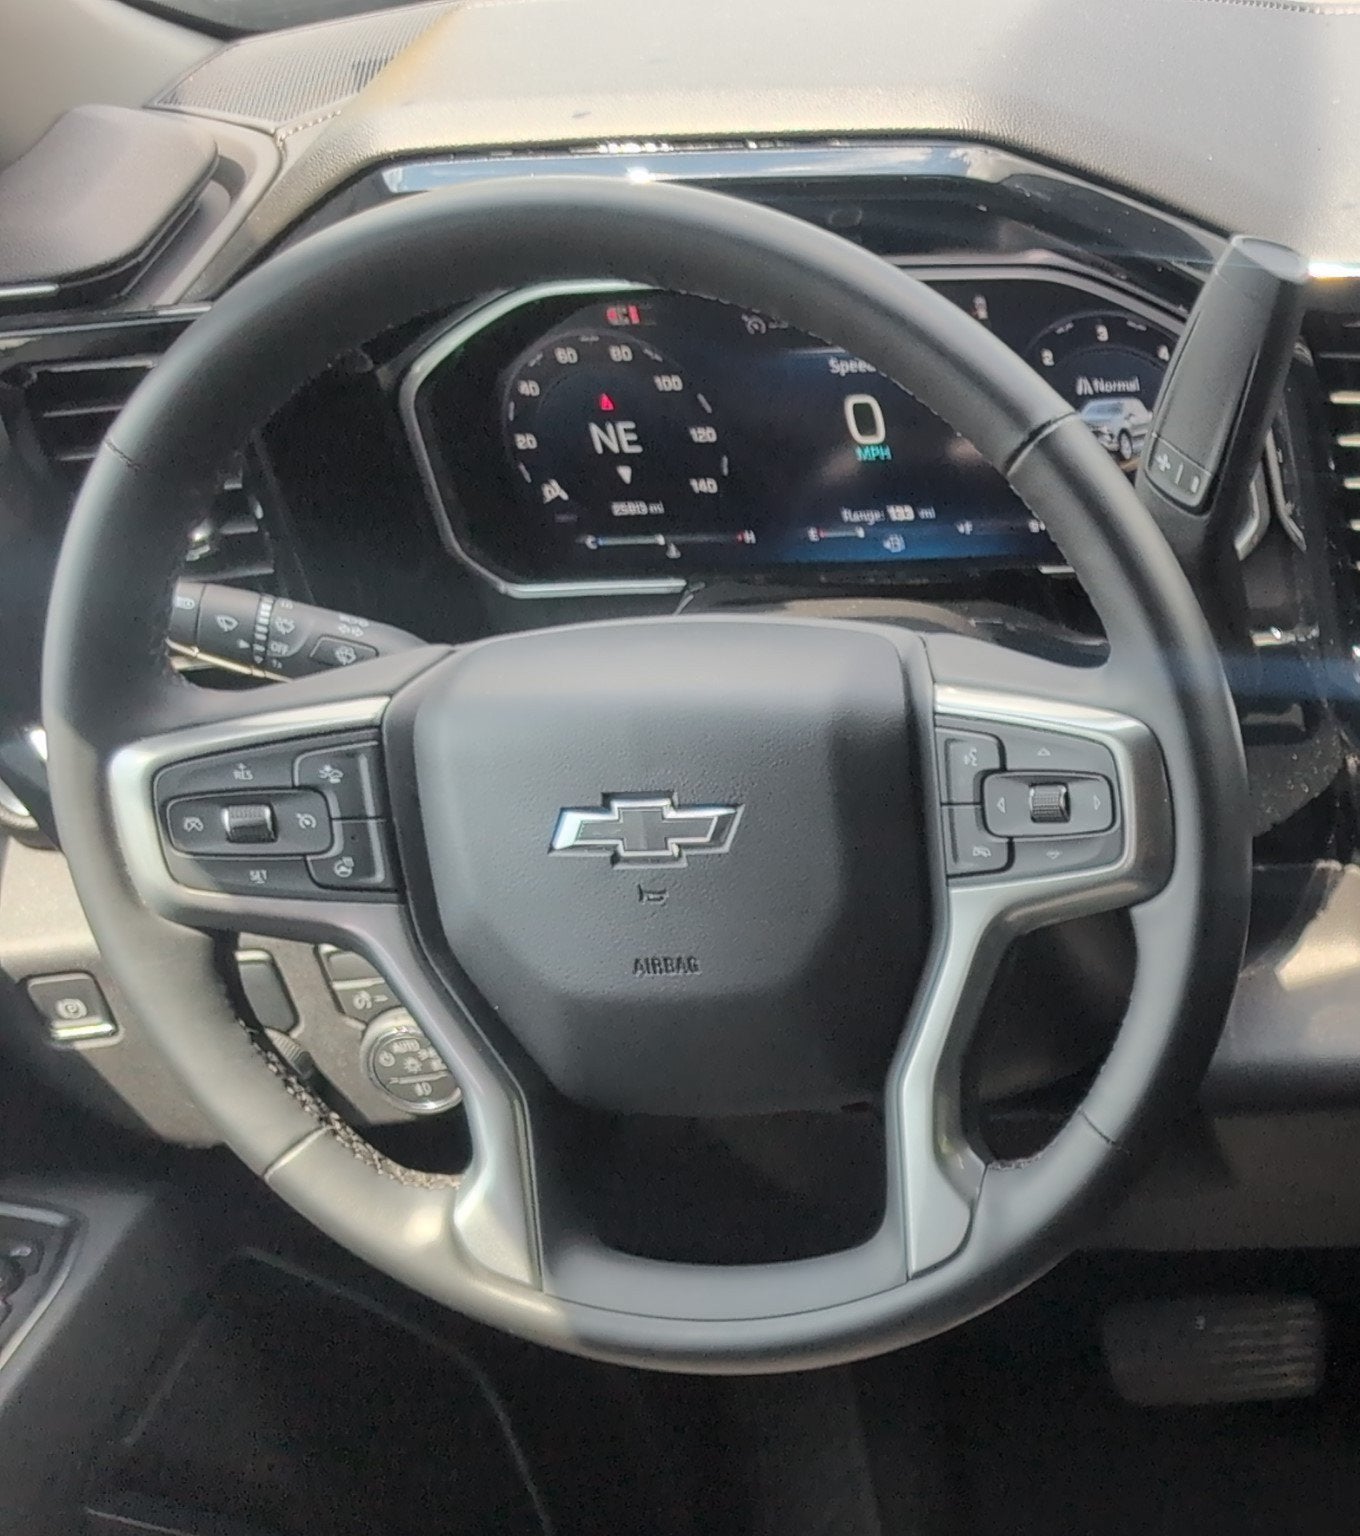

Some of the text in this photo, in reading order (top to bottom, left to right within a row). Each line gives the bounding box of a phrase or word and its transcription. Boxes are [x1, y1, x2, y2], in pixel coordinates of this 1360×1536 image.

[518, 380, 540, 397] 40
[653, 375, 683, 392] 100
[1093, 377, 1140, 393] Normal
[844, 394, 886, 444] 0
[514, 433, 538, 449] 20
[588, 421, 643, 454] NE
[689, 426, 717, 443] 120
[855, 445, 892, 461] MPH
[689, 478, 718, 494] 140
[632, 955, 699, 976] AIRBAG
